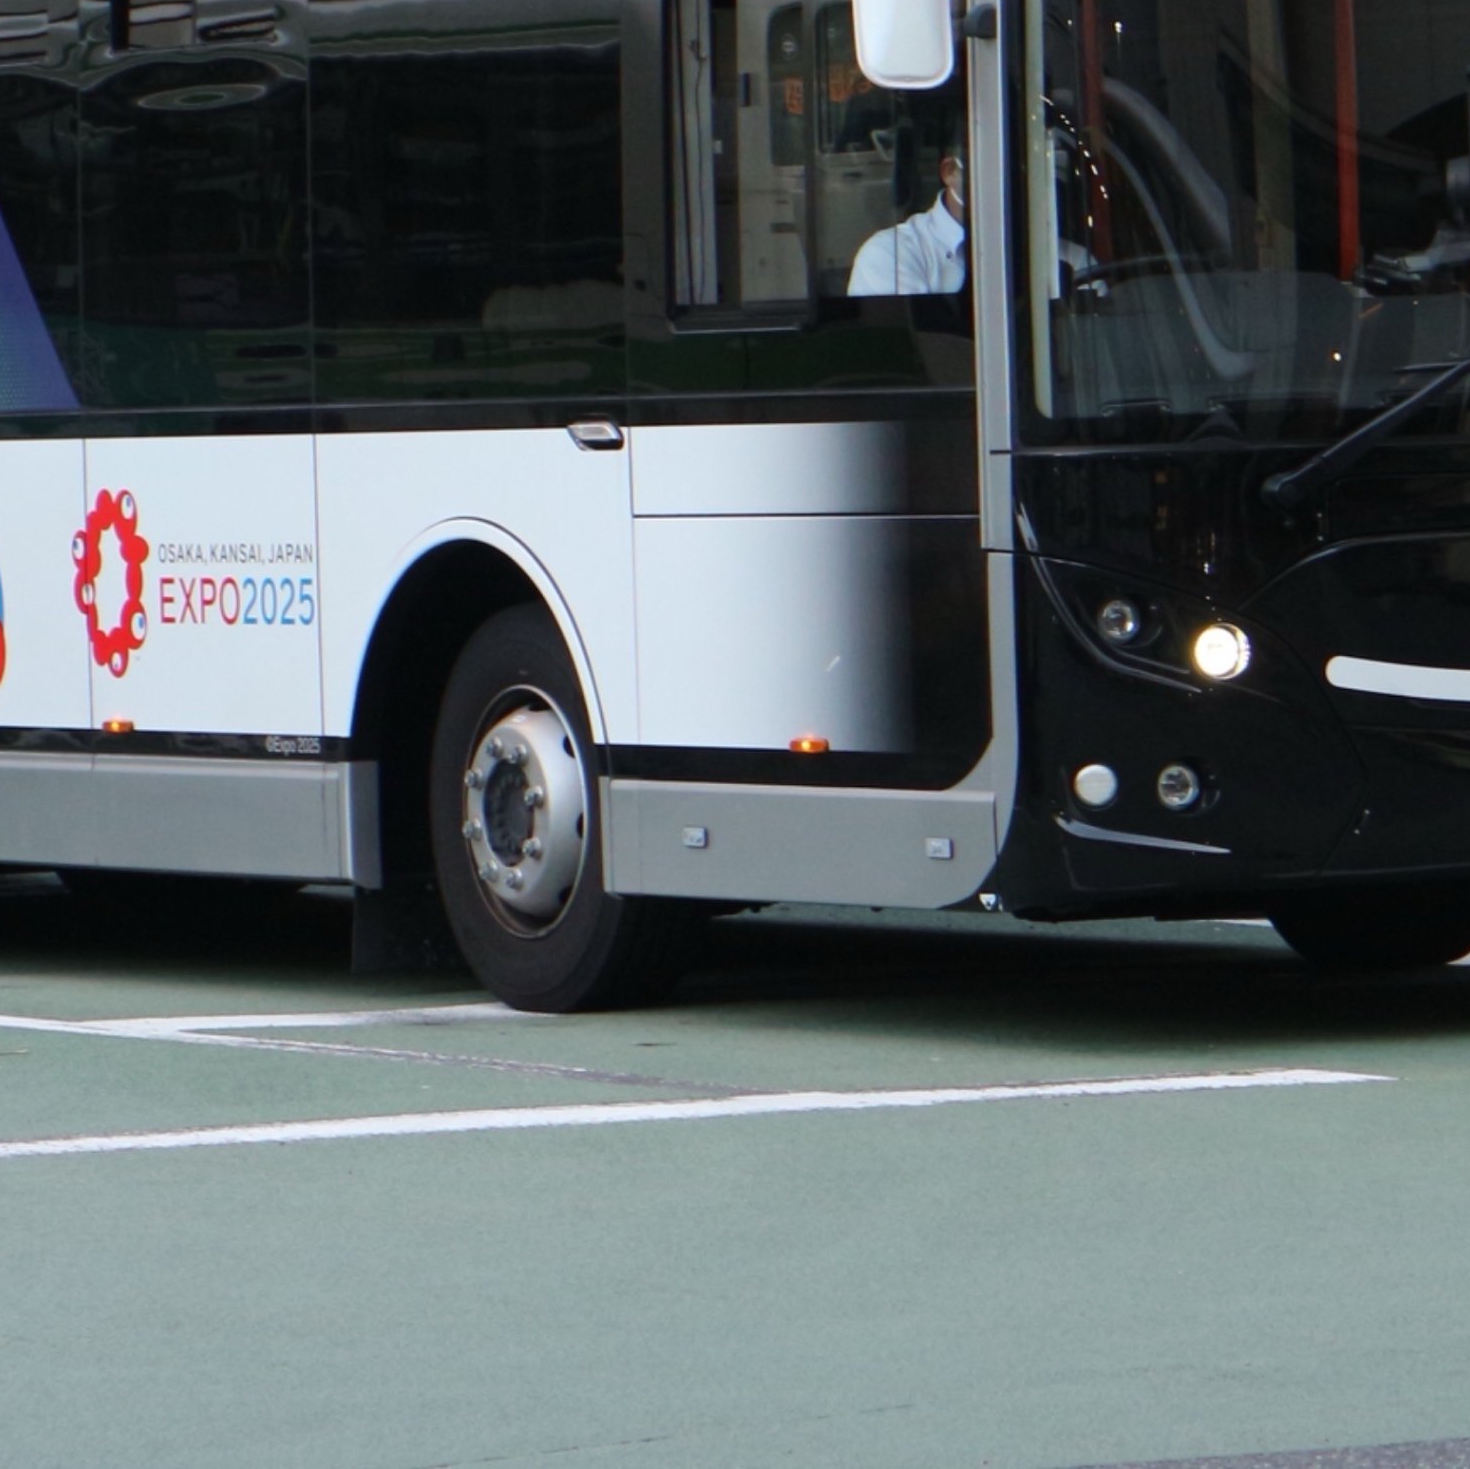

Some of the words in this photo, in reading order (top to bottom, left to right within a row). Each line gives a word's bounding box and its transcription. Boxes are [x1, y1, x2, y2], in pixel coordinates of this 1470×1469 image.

[158, 543, 207, 566] OSAKA,
[211, 543, 265, 566] KANSAI,
[267, 543, 313, 564] JAPAN
